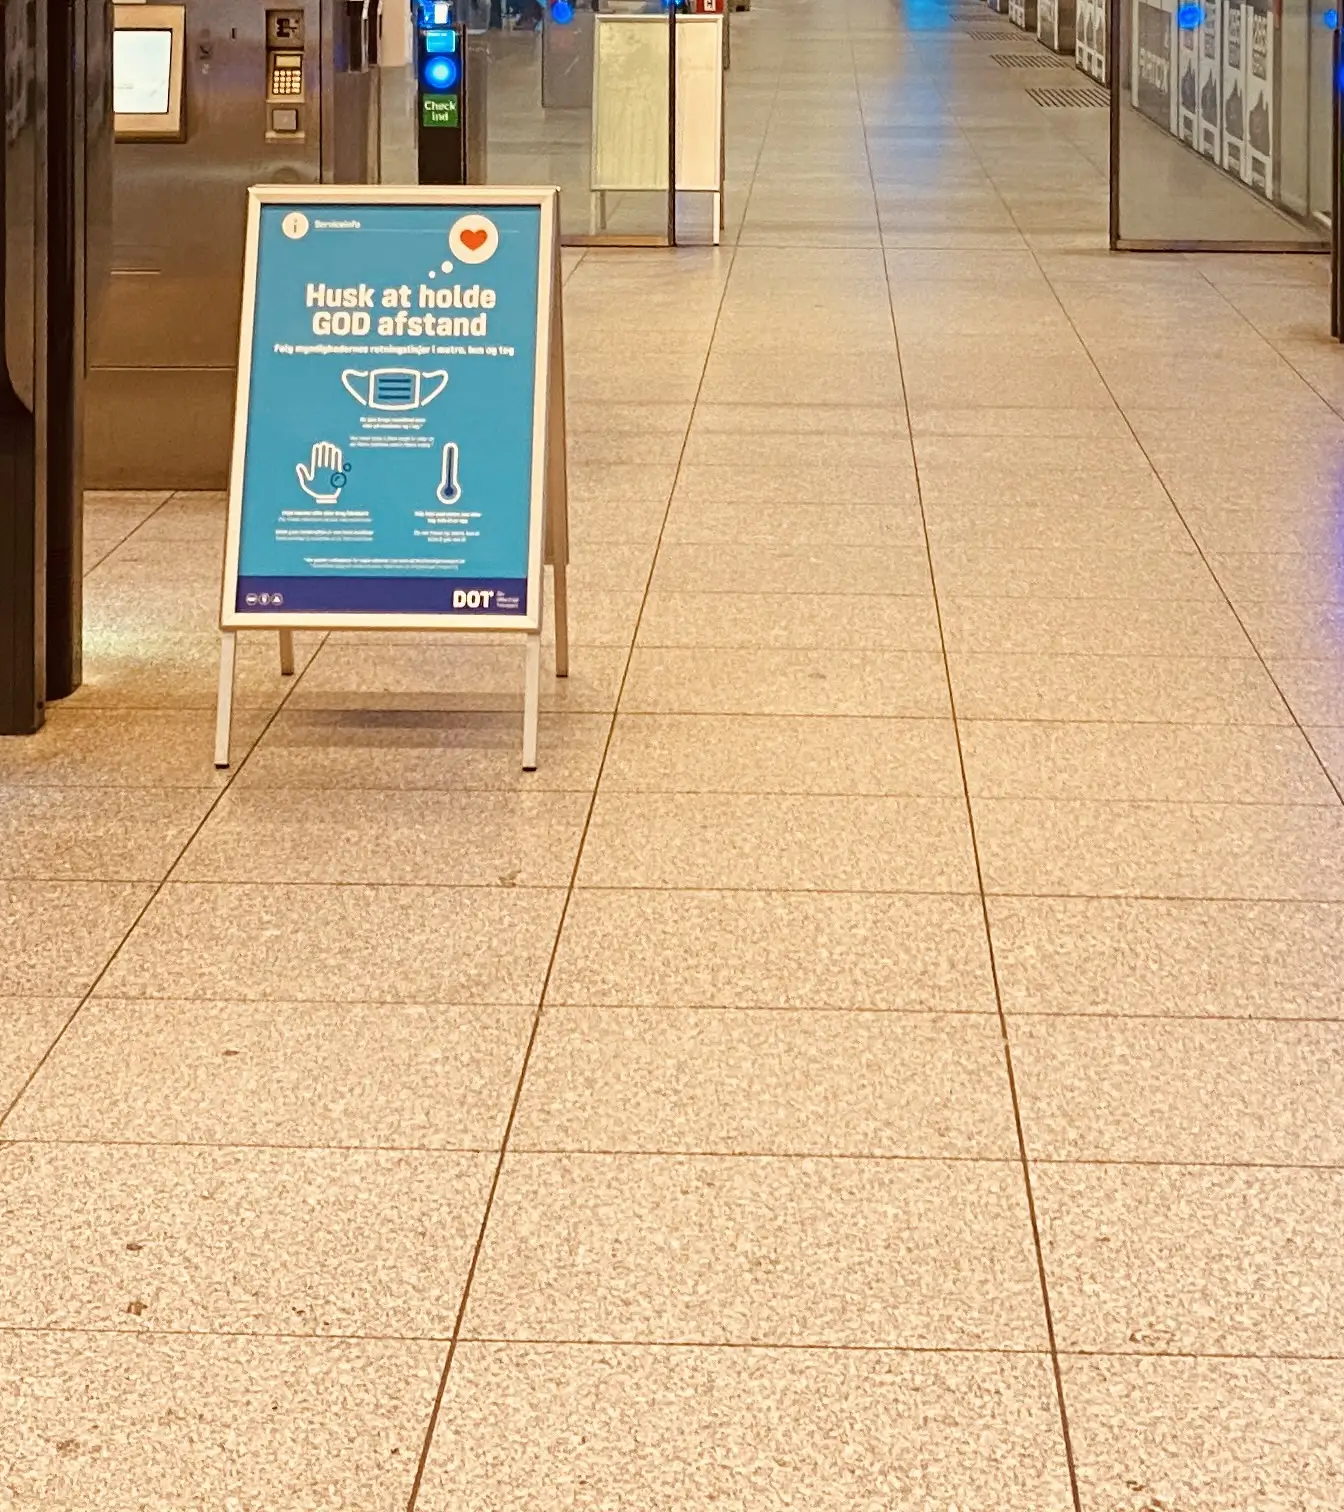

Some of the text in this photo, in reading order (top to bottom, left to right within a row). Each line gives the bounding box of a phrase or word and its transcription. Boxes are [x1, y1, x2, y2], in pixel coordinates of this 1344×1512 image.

[424, 99, 456, 111] Check
[432, 110, 449, 122] ind
[306, 283, 496, 309] Husk at holde
[312, 311, 487, 337] GOD afstand
[453, 590, 494, 608] DOT
